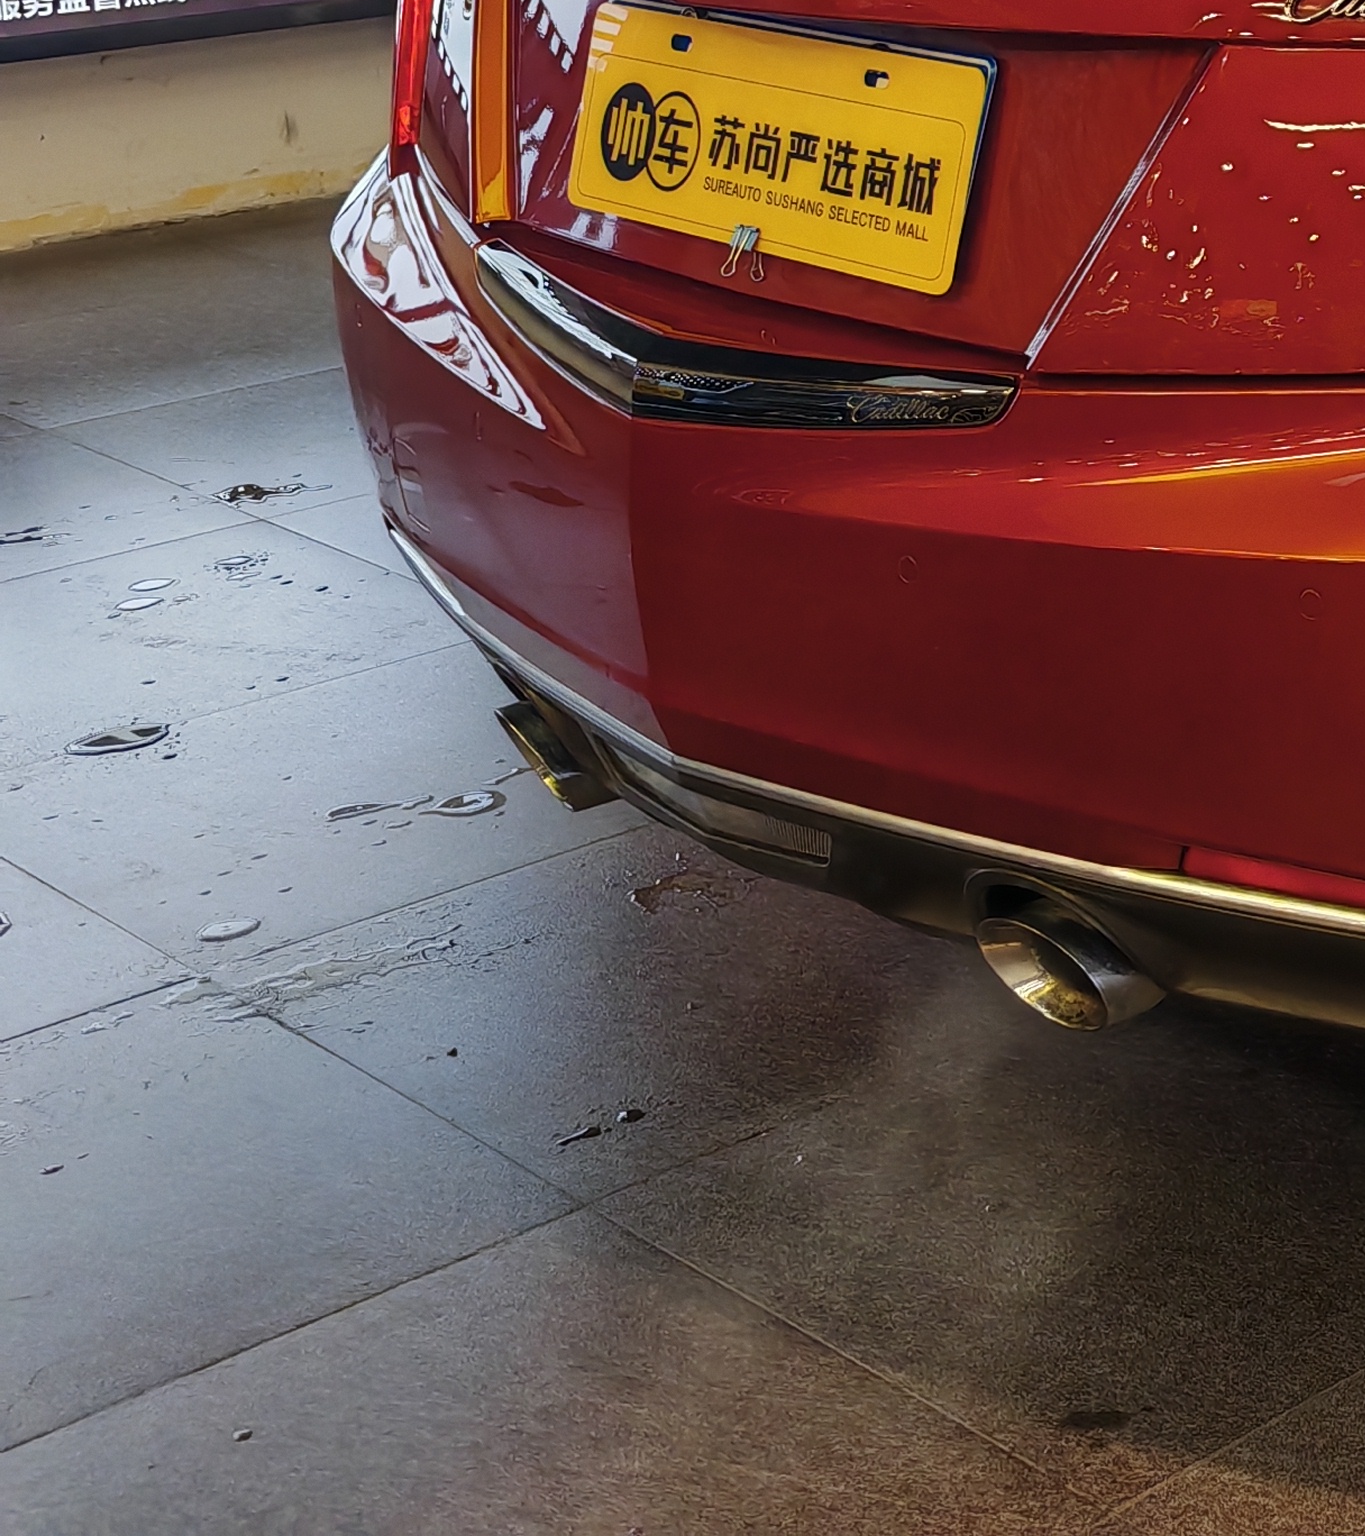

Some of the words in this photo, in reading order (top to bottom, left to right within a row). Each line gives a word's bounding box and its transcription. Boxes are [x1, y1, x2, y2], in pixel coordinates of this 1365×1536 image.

[606, 94, 696, 176] 帅车
[708, 114, 942, 216] 苏尚严选商城
[703, 175, 762, 203] SUREAUTO
[765, 191, 824, 218] SUSHANG
[828, 205, 891, 233] SELECTED
[895, 218, 929, 242] MALL
[846, 395, 951, 423] Cadillac
